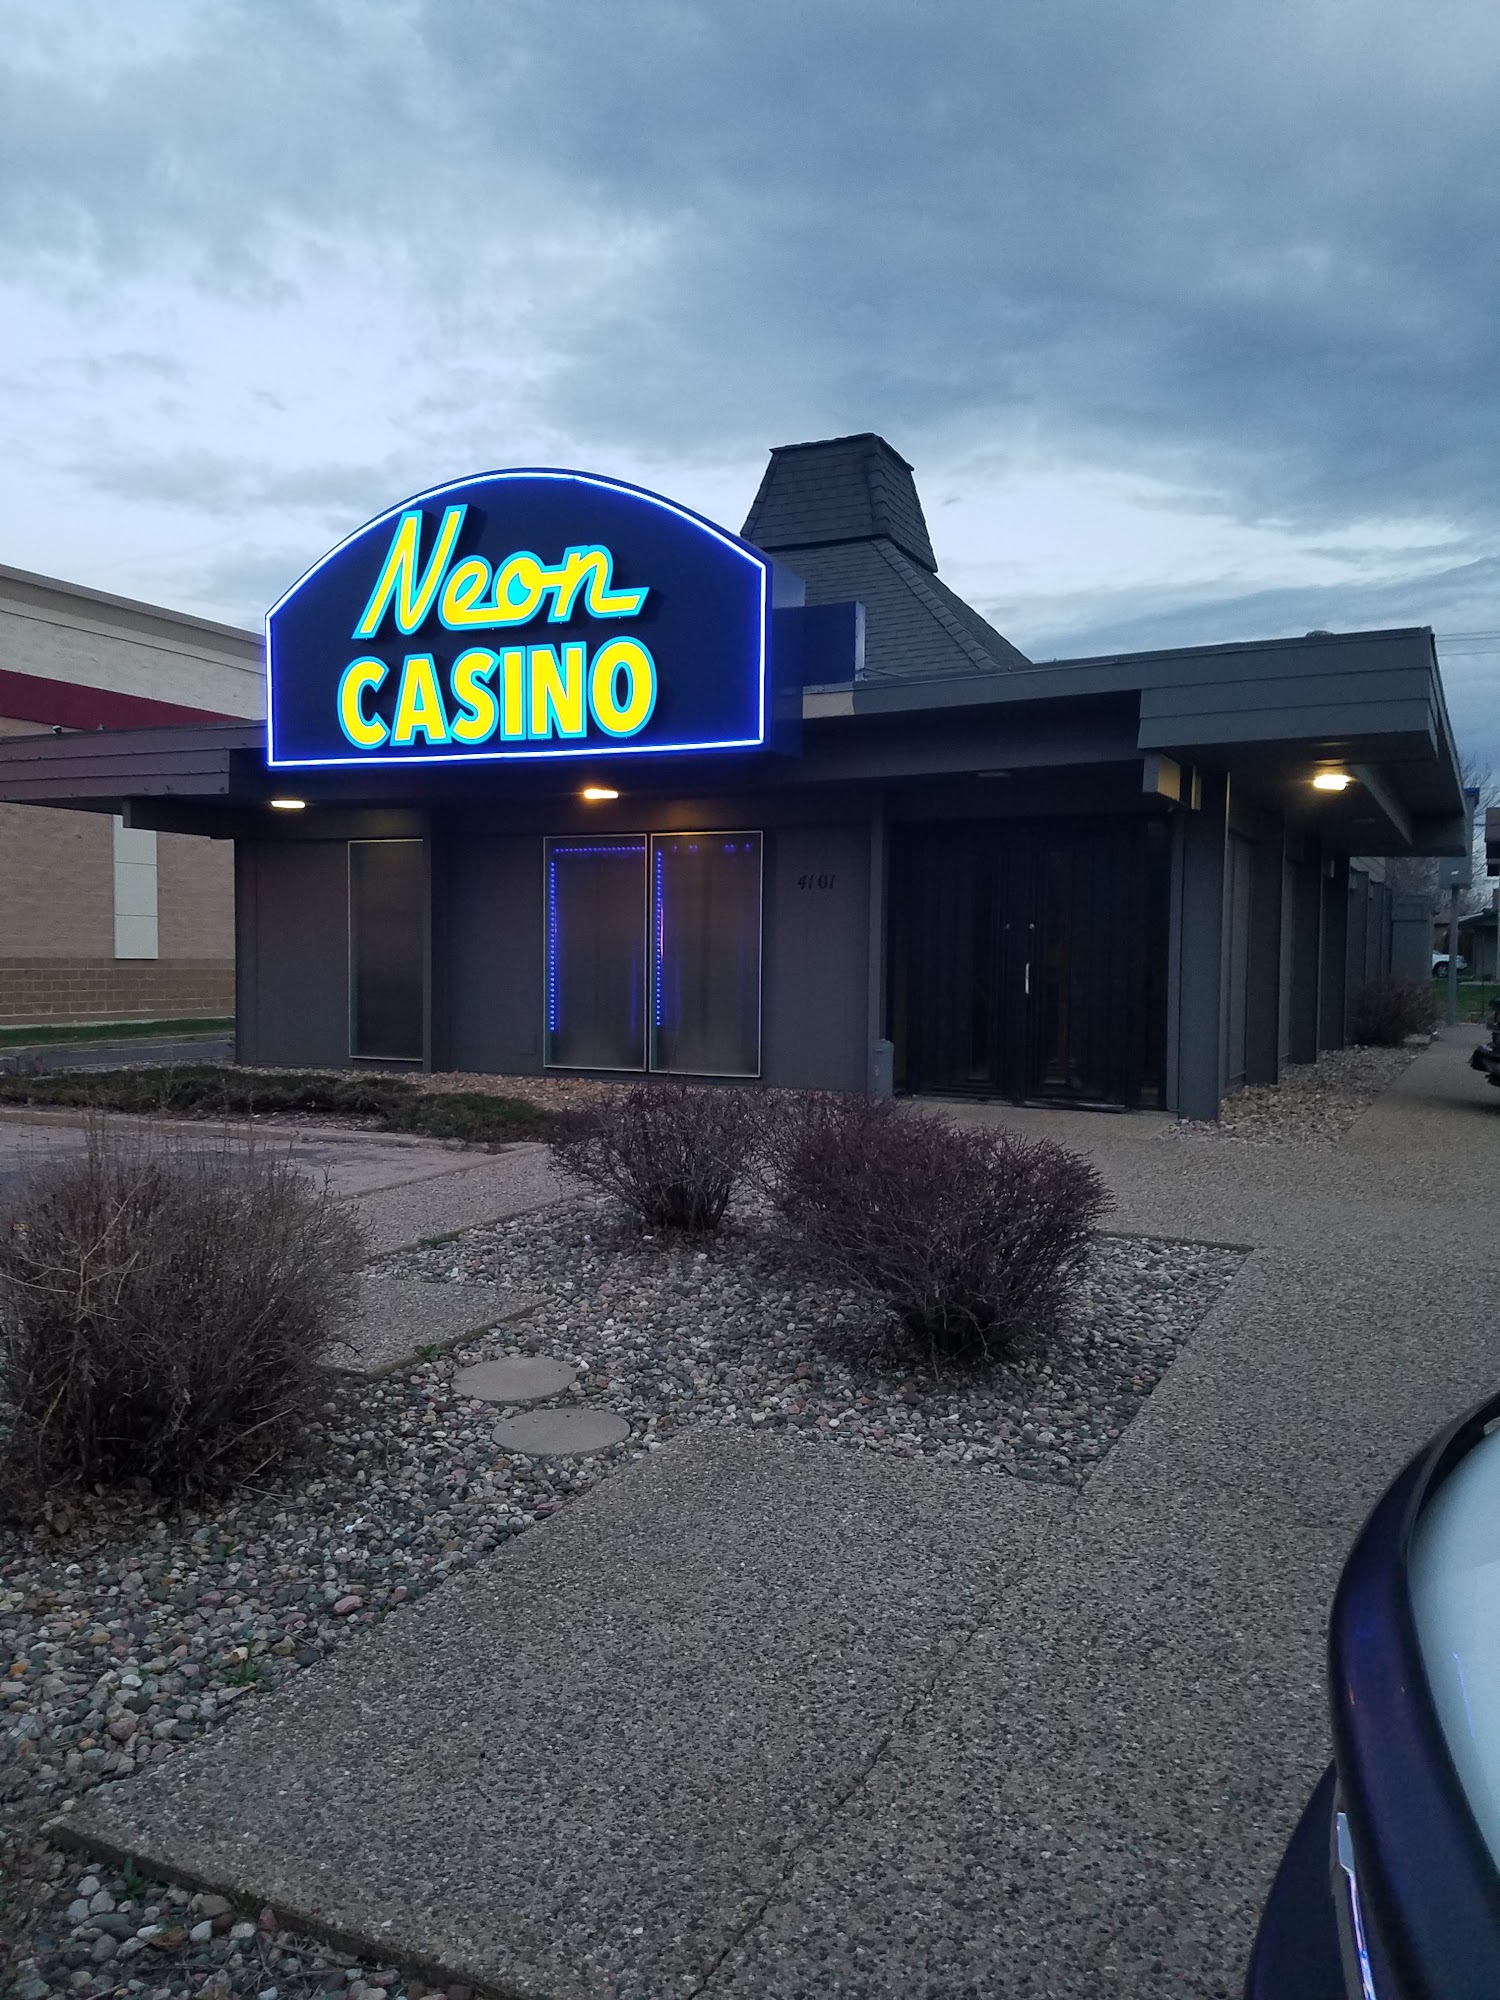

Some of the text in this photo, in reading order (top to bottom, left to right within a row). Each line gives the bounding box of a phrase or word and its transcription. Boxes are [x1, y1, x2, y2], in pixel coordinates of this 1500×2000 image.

[352, 504, 649, 639] Neon
[338, 637, 657, 749] CASINO
[797, 873, 836, 890] 4101
